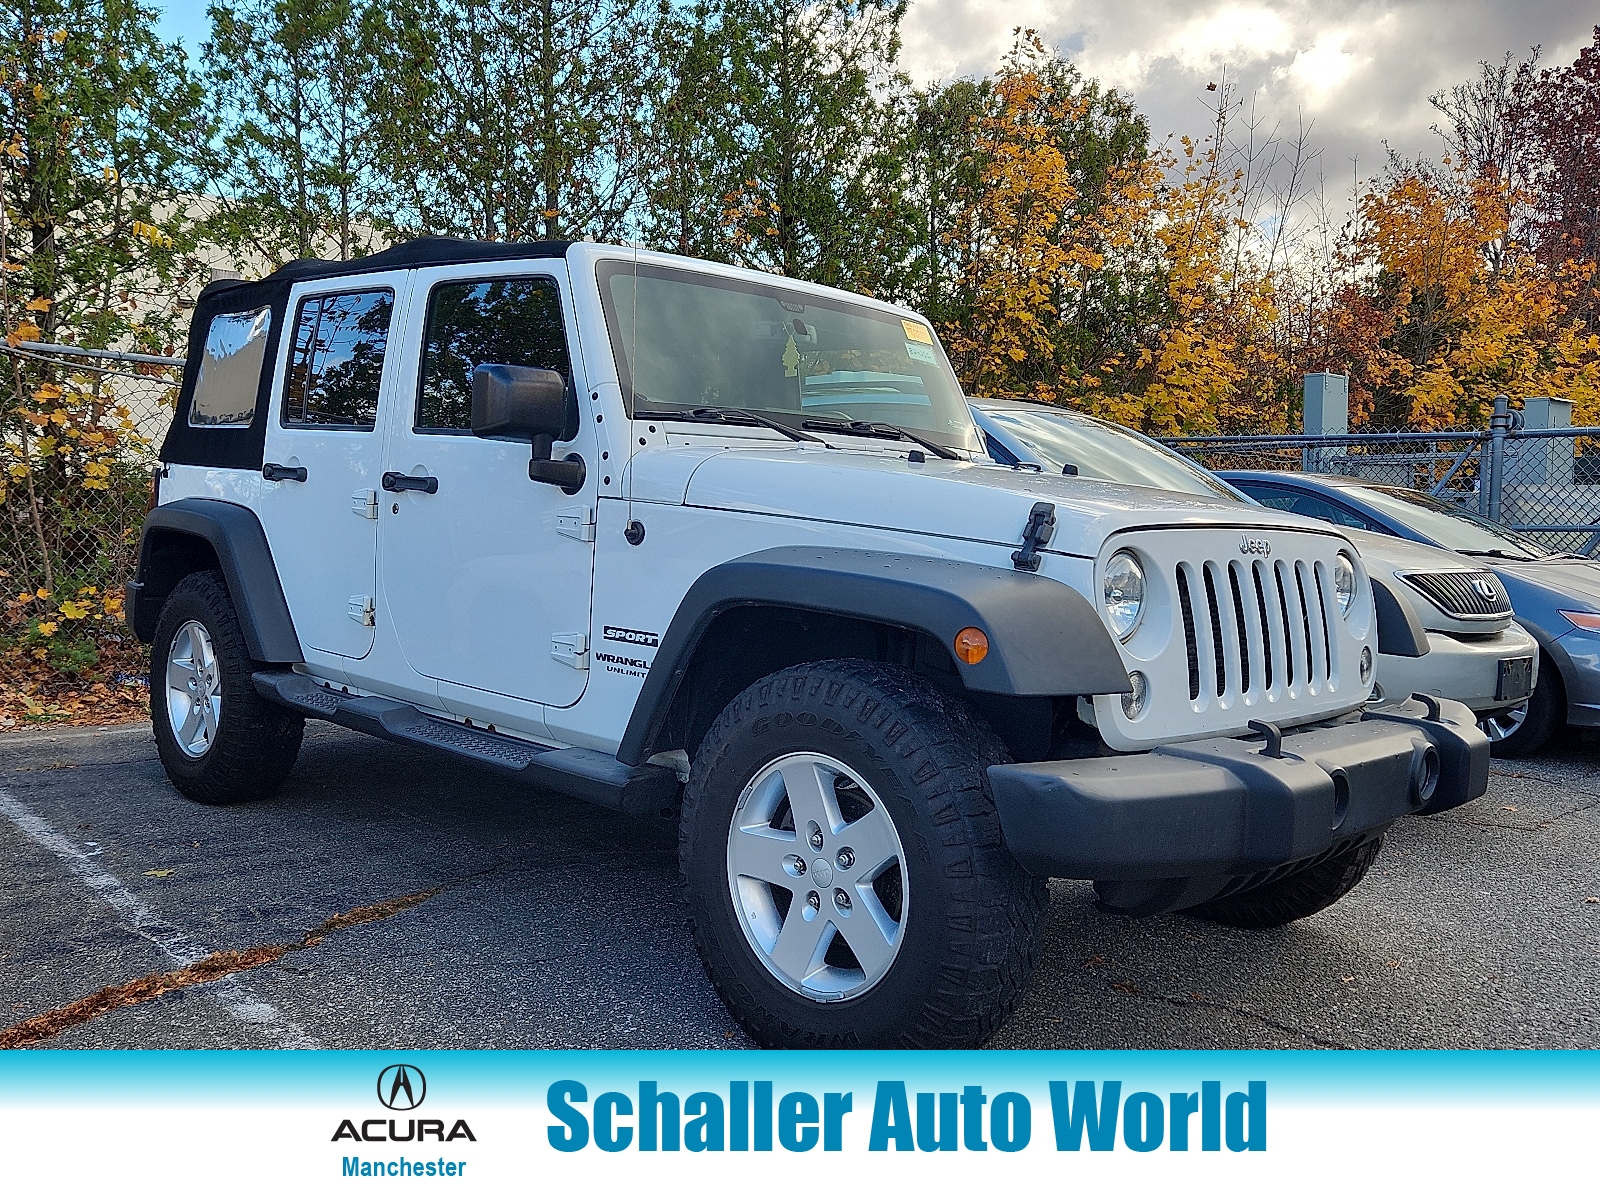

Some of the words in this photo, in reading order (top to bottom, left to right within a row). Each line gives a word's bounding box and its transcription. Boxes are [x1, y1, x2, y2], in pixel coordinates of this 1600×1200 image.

[1239, 534, 1271, 558] Jeep
[606, 629, 656, 643] SPORT
[595, 652, 652, 669] WRANGL
[606, 666, 646, 678] UNLIMIT
